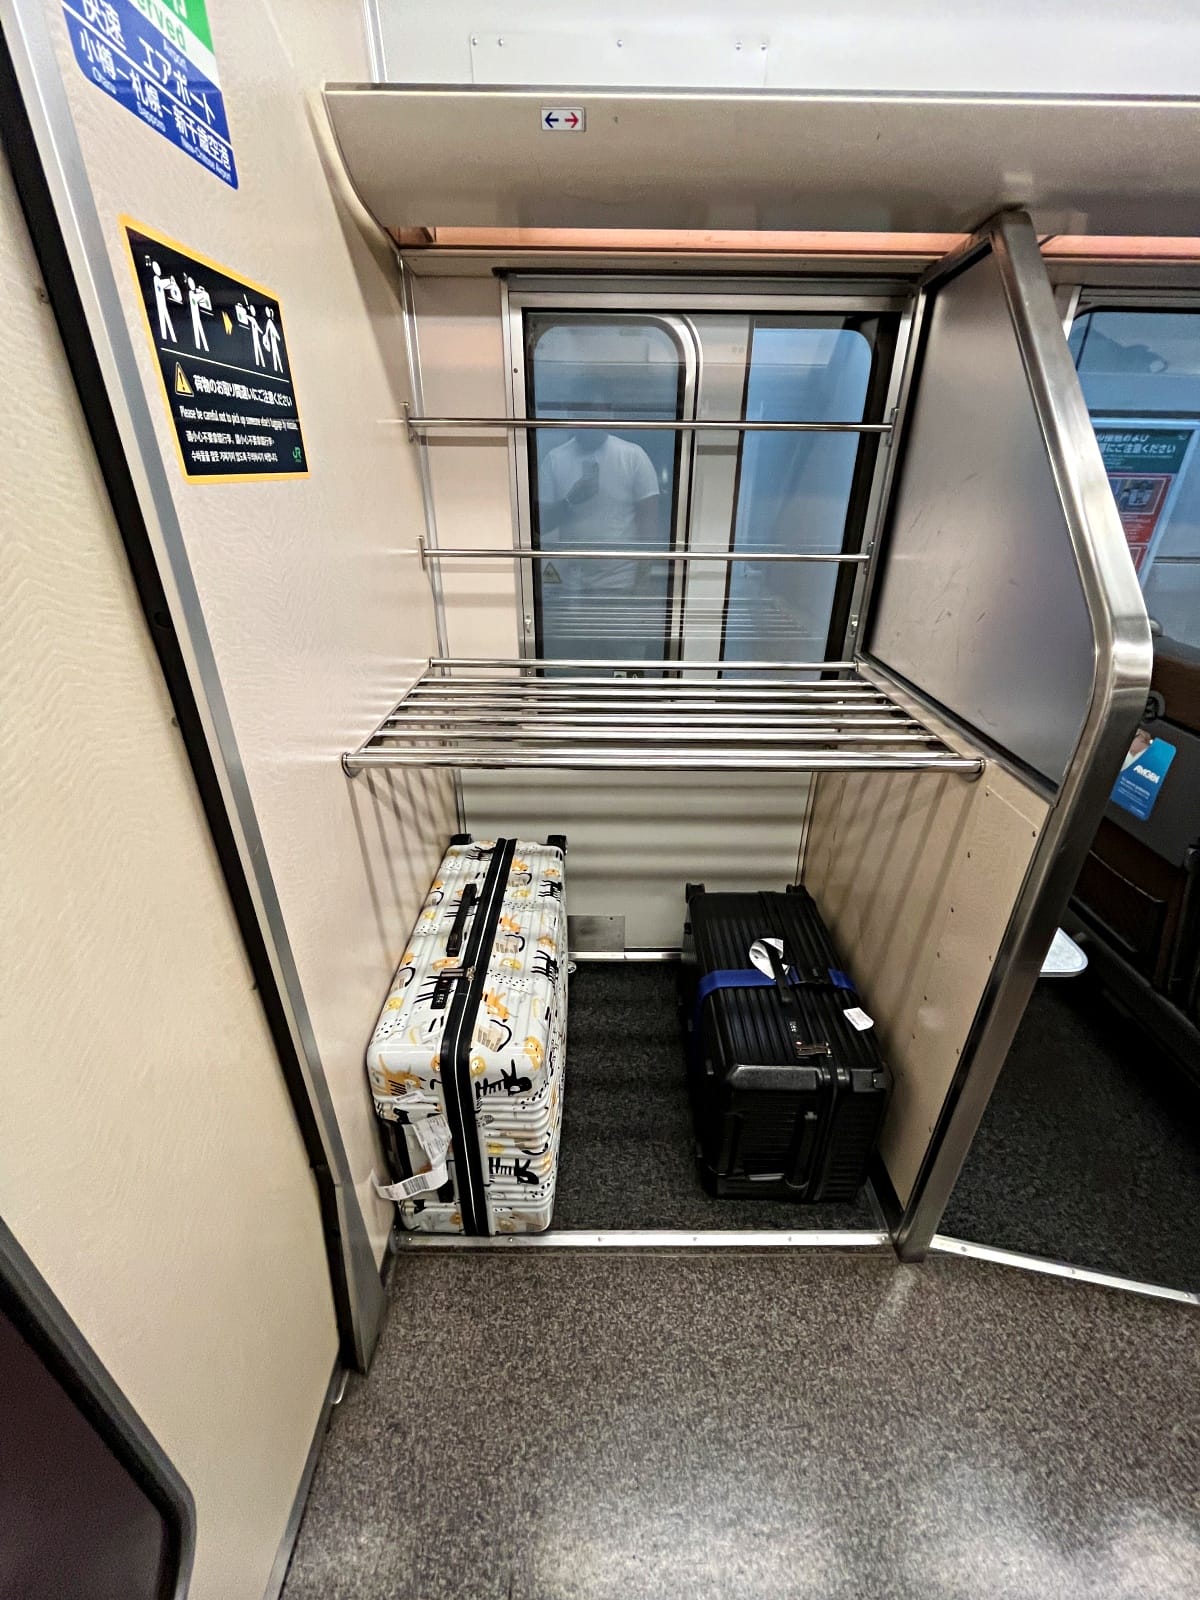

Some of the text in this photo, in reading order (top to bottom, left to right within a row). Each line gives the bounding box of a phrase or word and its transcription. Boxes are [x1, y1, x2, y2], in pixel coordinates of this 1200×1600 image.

[139, 36, 215, 125] エアポート
